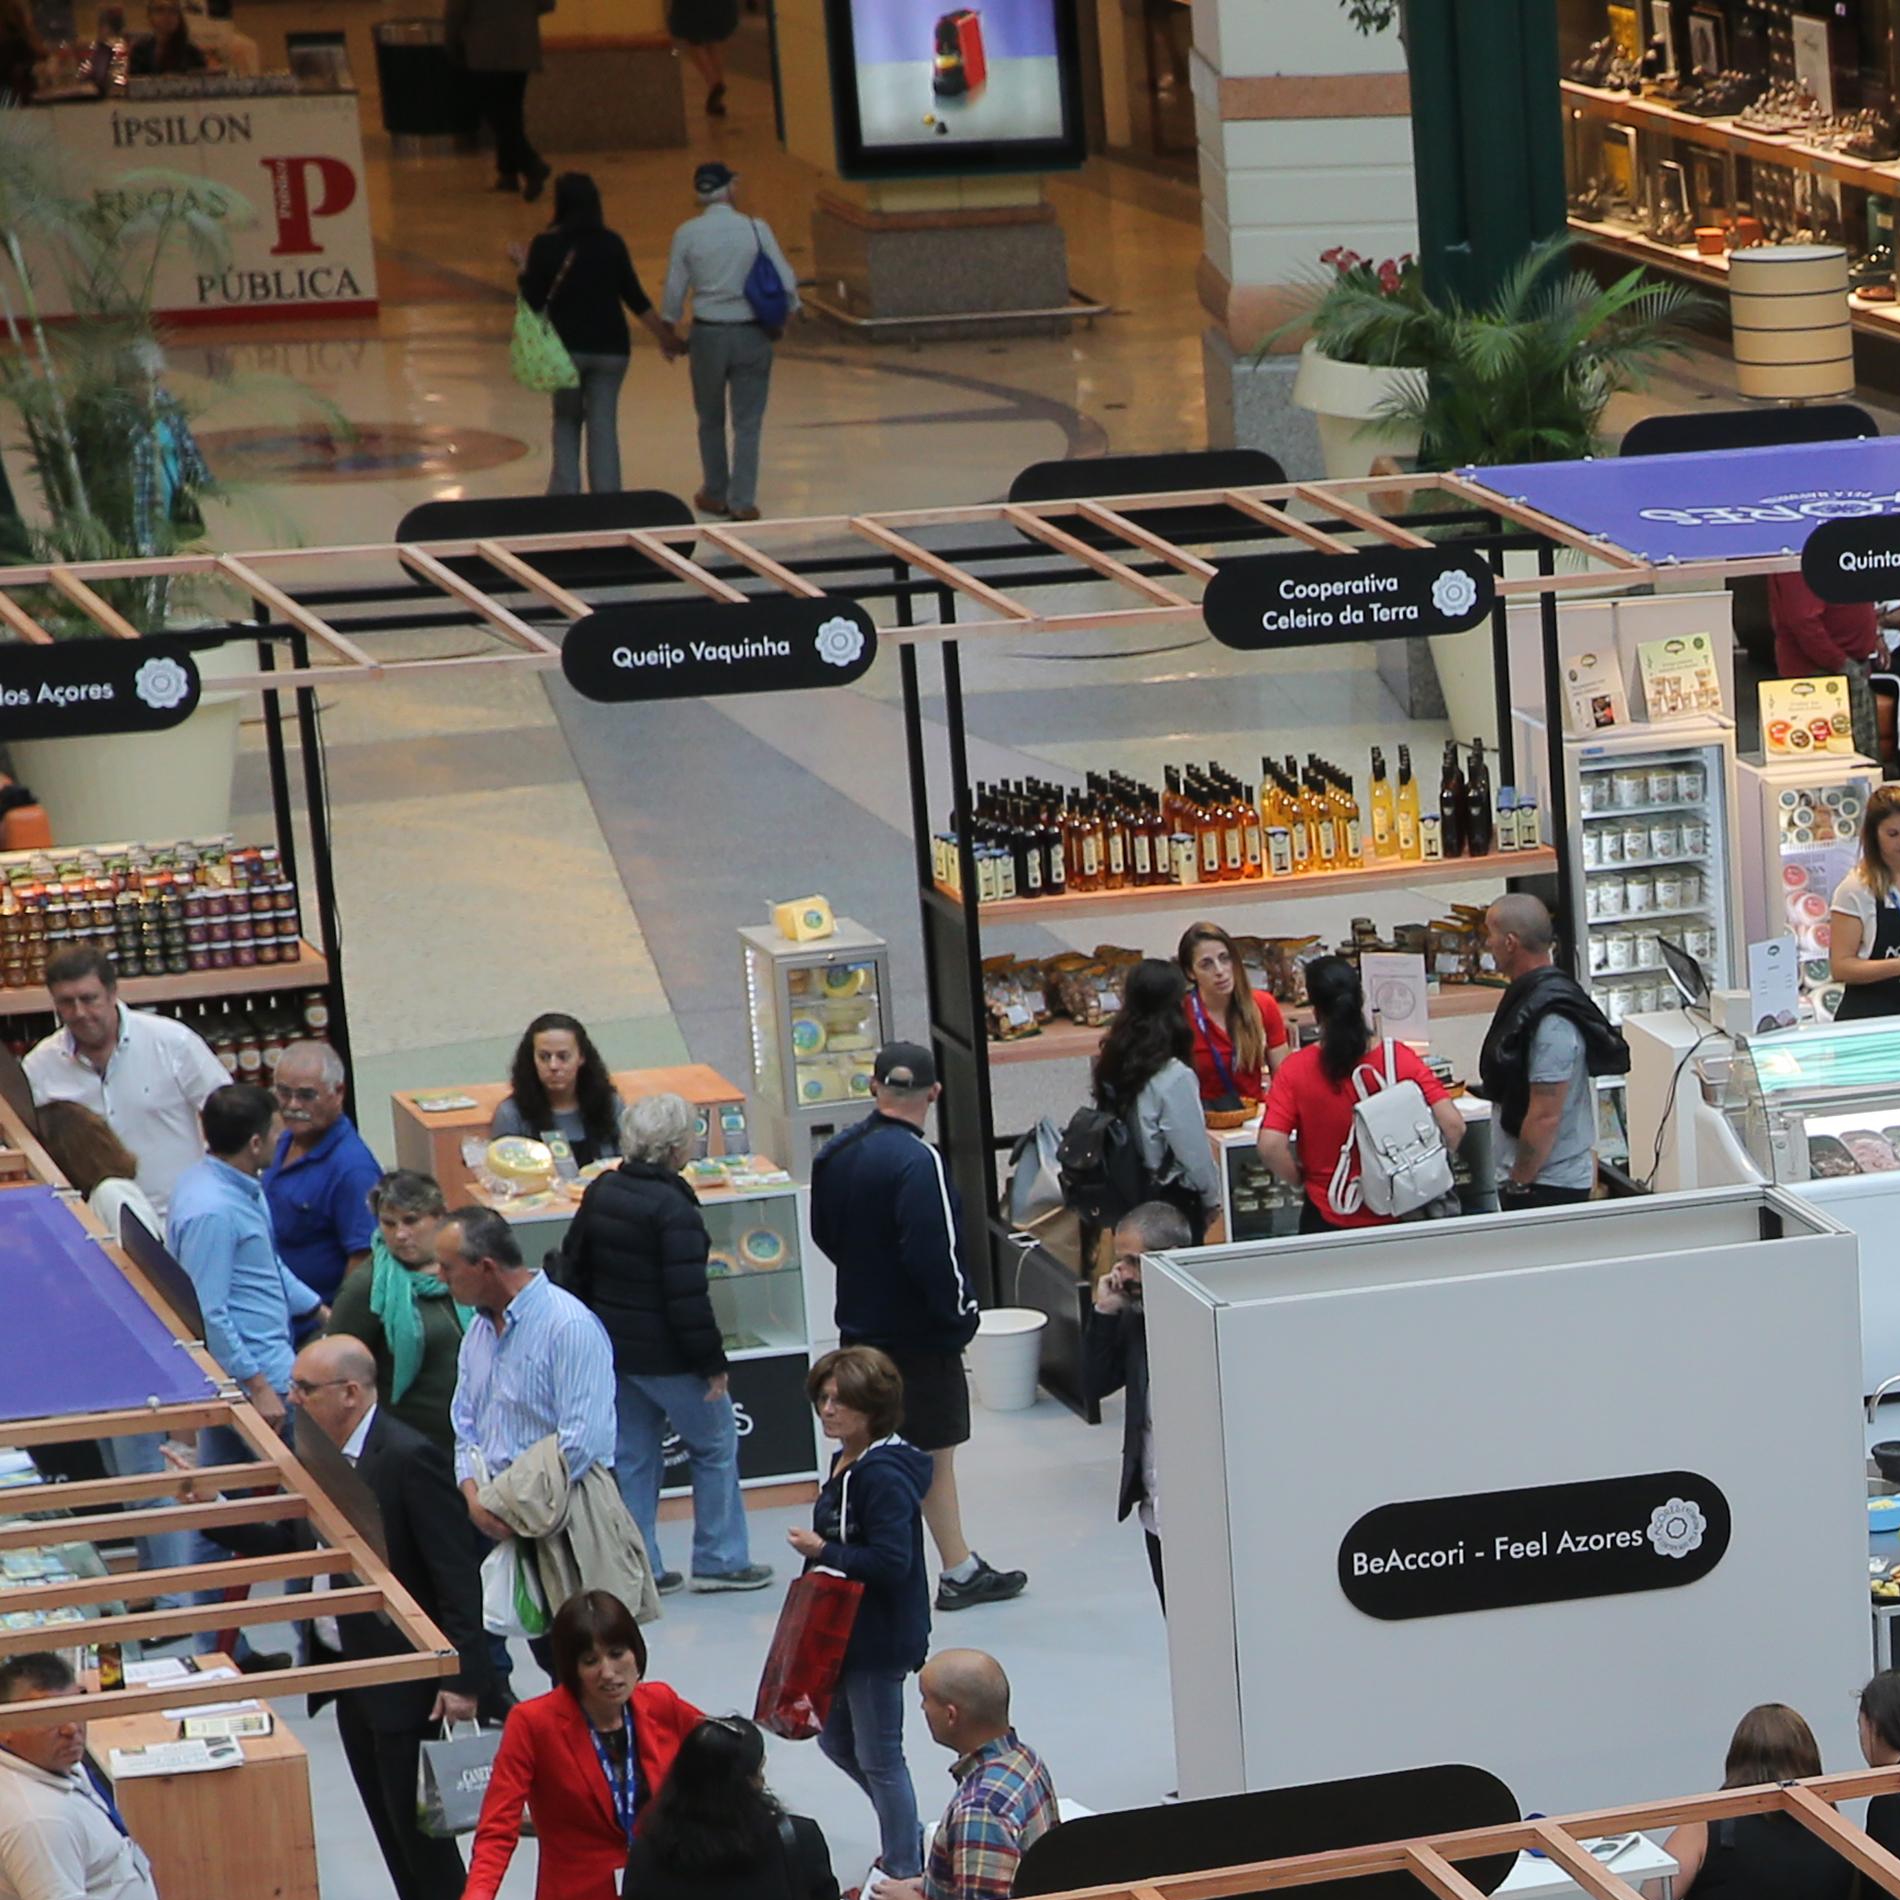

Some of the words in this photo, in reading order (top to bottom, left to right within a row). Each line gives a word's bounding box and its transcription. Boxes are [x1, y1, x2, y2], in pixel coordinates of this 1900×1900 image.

[112, 111, 252, 147] ÍPSILON
[197, 265, 360, 303] PÚBLICA
[1279, 574, 1398, 603] Cooperativa
[1262, 607, 1334, 632] Celeiro
[1339, 605, 1365, 627] da
[1370, 601, 1418, 624] Terra
[612, 644, 685, 669] Queijo
[690, 636, 790, 663] Vaquinha
[37, 682, 114, 708] Açores
[1352, 1541, 1467, 1578] BeAccori
[1496, 1530, 1547, 1563] Feel
[1556, 1522, 1644, 1557] Azores
